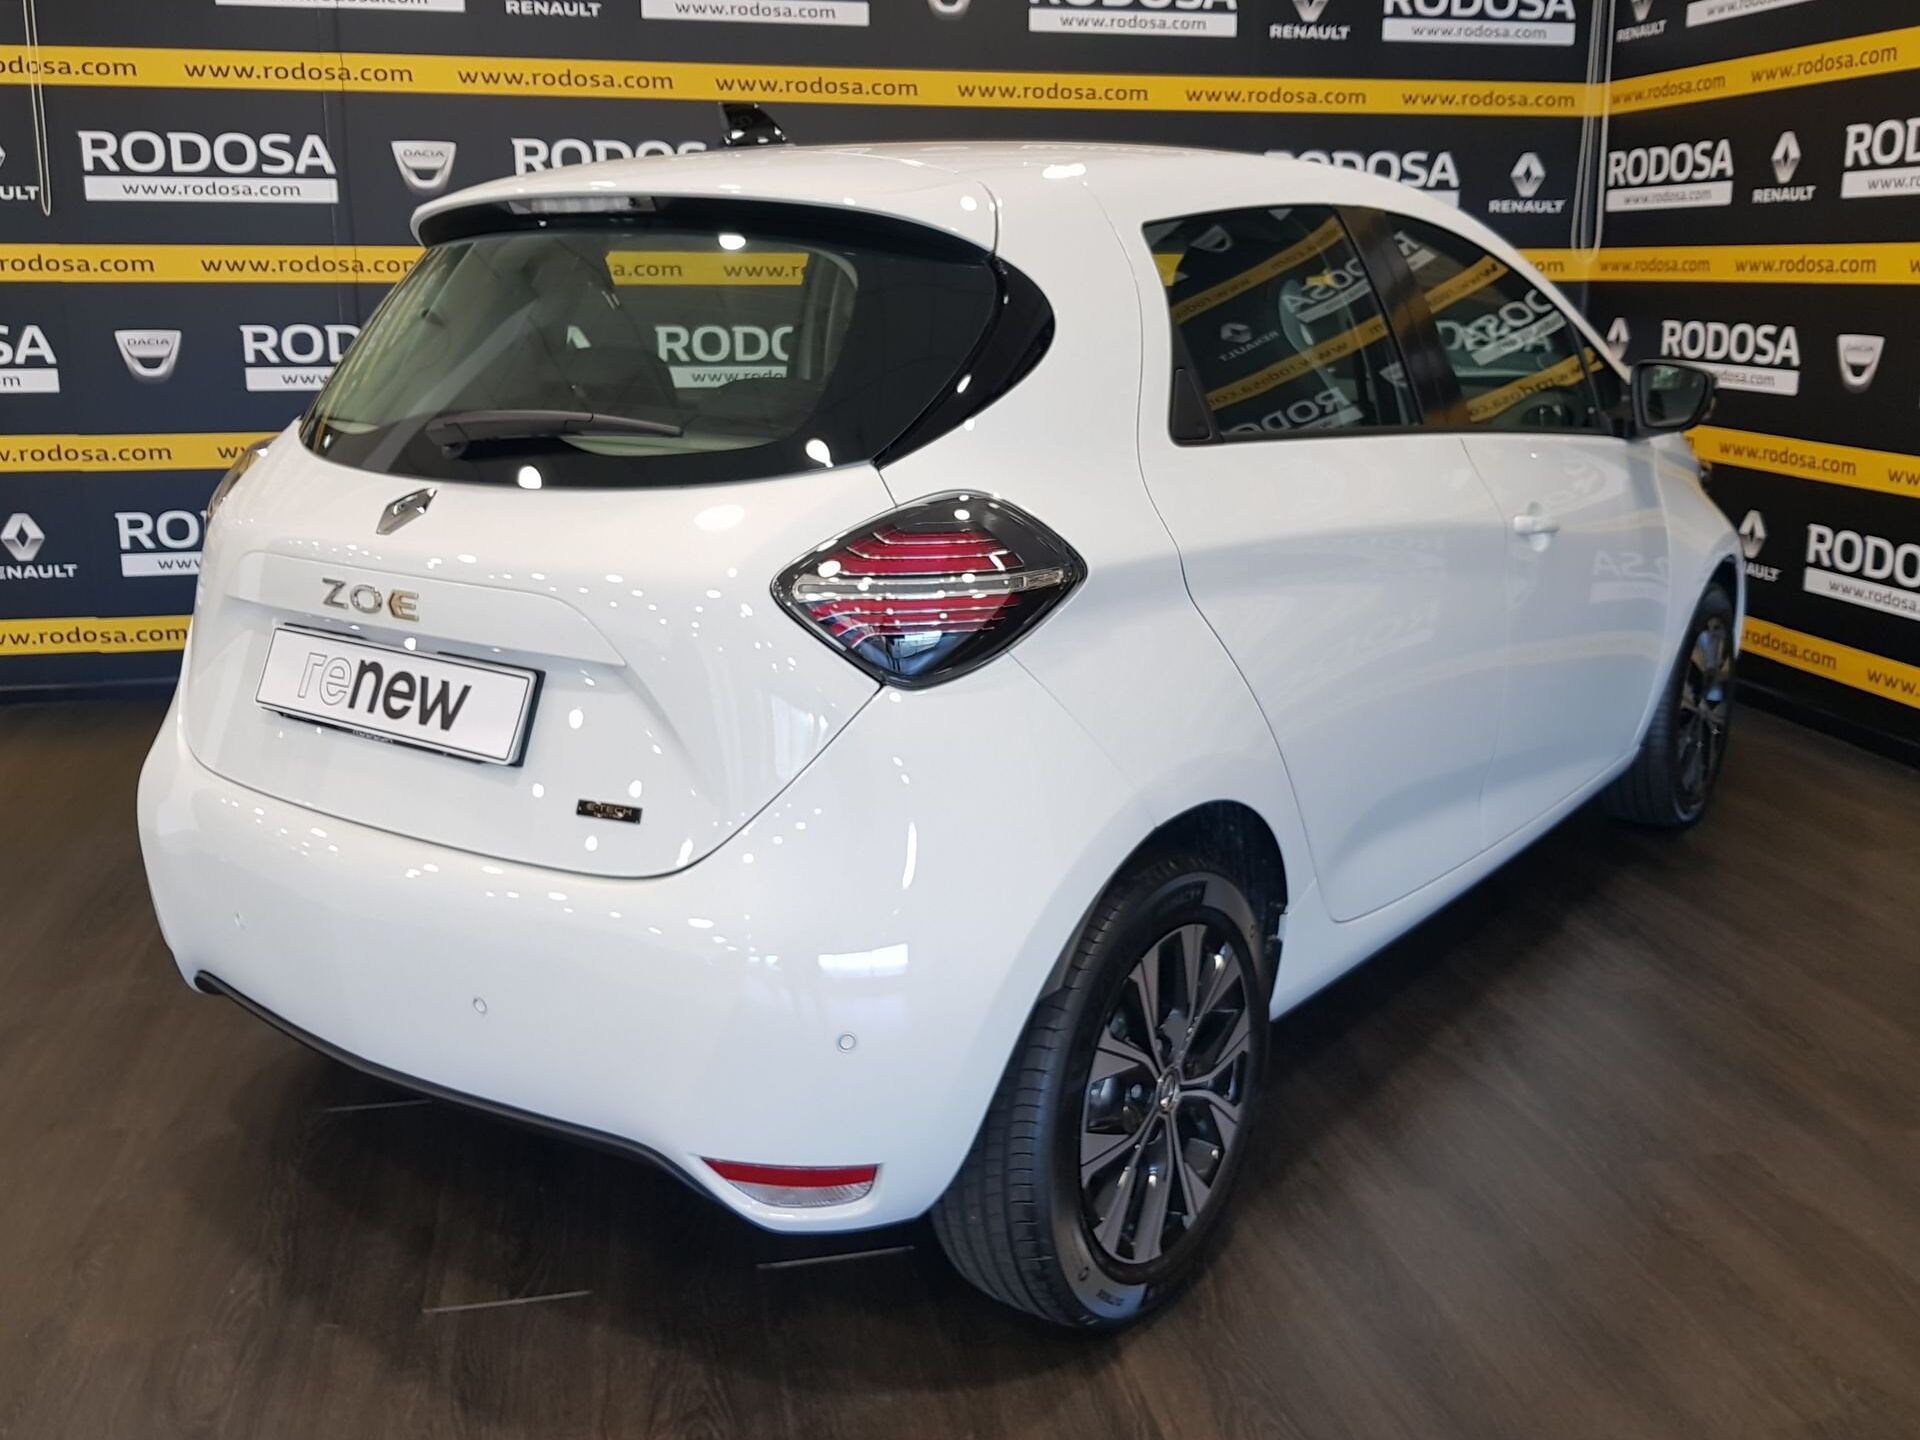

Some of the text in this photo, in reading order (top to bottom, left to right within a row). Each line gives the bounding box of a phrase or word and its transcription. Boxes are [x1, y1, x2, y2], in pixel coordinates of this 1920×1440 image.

[505, 1, 603, 17] RENAULT
[674, 2, 837, 20] www.rodosa.com
[1059, 15, 1206, 31] www.rodosa.com
[1269, 24, 1351, 41] RENAULT
[1411, 24, 1547, 40] www.rodosa.com
[1616, 20, 1667, 42] RENAULT
[184, 62, 413, 83] www.rodosa.com
[1751, 45, 1898, 83] www.rodosa.com
[458, 68, 673, 90] www.rodosa.com
[715, 76, 918, 97] www.rodosa.com
[957, 81, 1149, 102] www.rodosa.com
[1185, 86, 1367, 106] www.rodosa.com
[1401, 89, 1576, 108] www.rodosa.com
[1611, 73, 1726, 106] www.rodosa.com
[77, 131, 336, 175] RODOSA
[402, 147, 445, 158] DACIA
[1607, 138, 1734, 187] RODOSA
[122, 181, 301, 198] www.rodosa.com
[1622, 188, 1712, 205] www.rodosa.com
[1752, 185, 1817, 204] RENAULT
[1488, 199, 1567, 214] RENAULT
[1600, 257, 1711, 272] www.rodosa.com
[1735, 254, 1877, 274] www.rodosa.com
[1660, 319, 1801, 367] RODOSA
[1719, 440, 1857, 476] www.rodosa.com
[115, 509, 207, 551] RO
[1805, 523, 1920, 589] RODO
[1744, 563, 1783, 582] AULT
[321, 577, 421, 622] ZOE
[296, 651, 472, 732] renew
